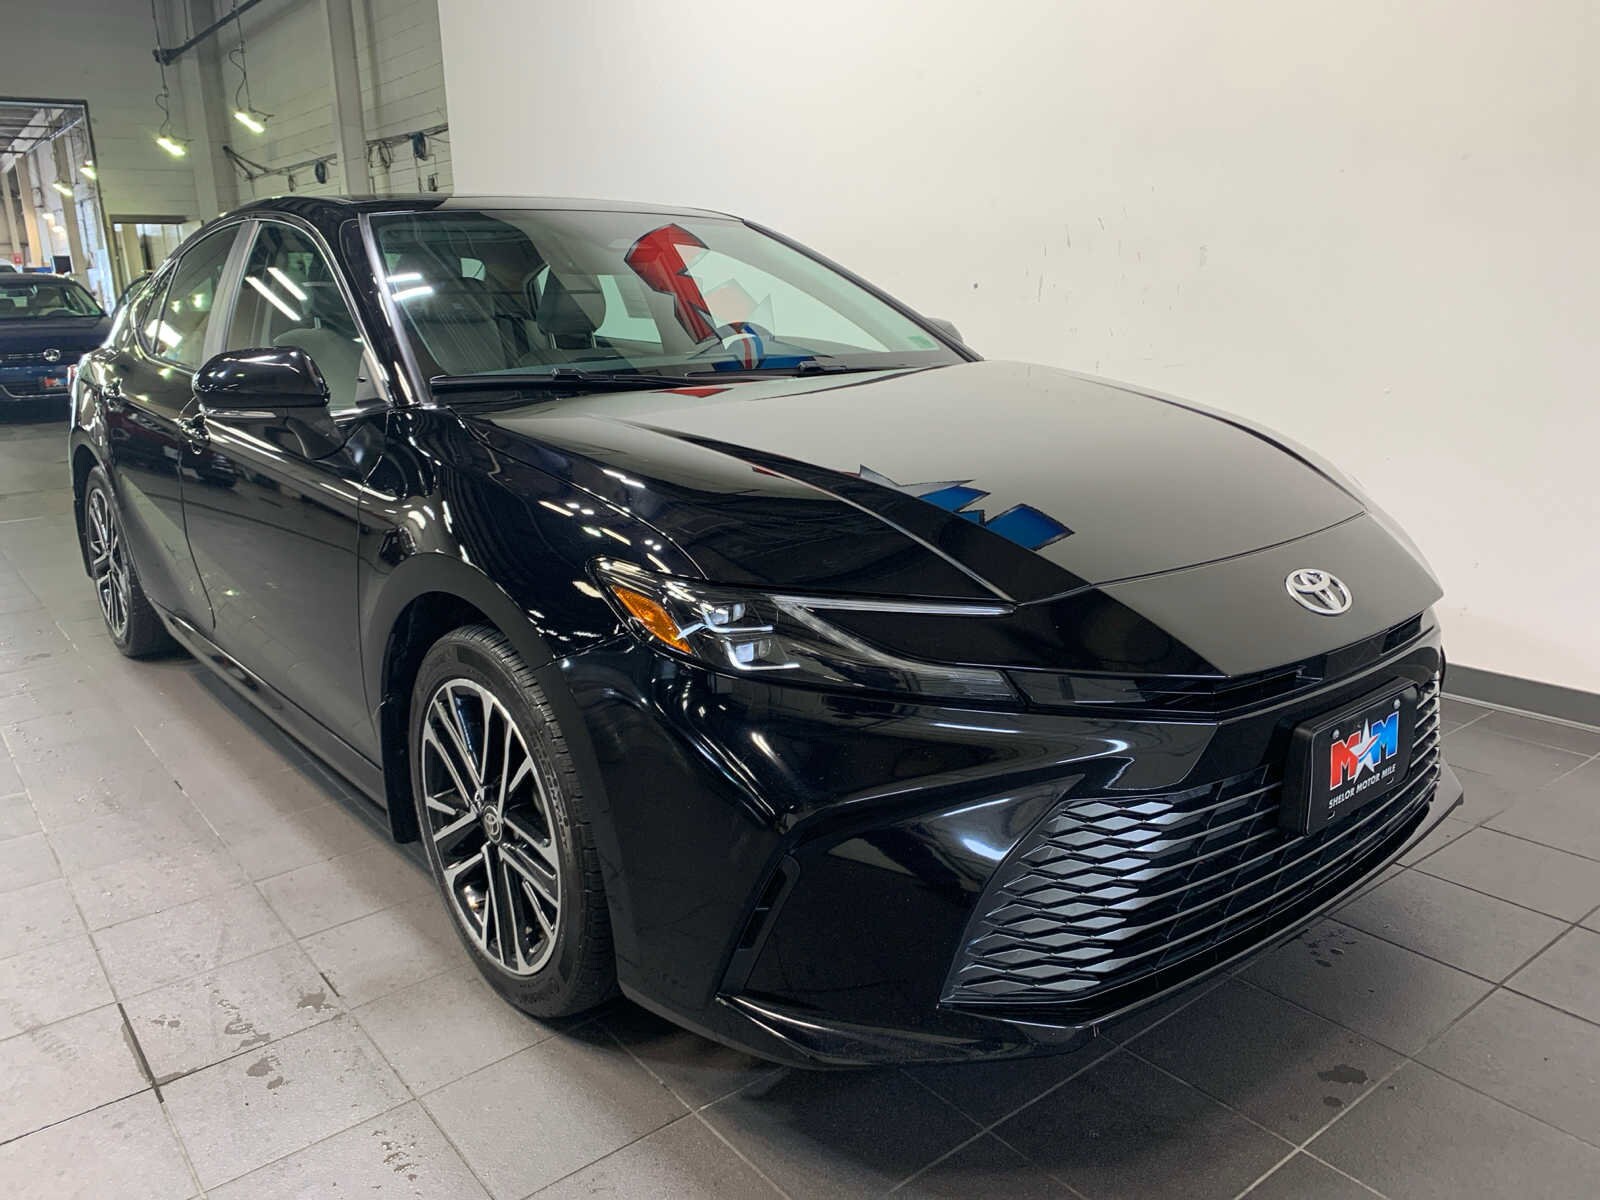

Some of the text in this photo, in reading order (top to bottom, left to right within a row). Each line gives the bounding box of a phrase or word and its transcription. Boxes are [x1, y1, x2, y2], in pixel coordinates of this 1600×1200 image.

[1328, 763, 1397, 809] SHELOR MOTOR MILE
